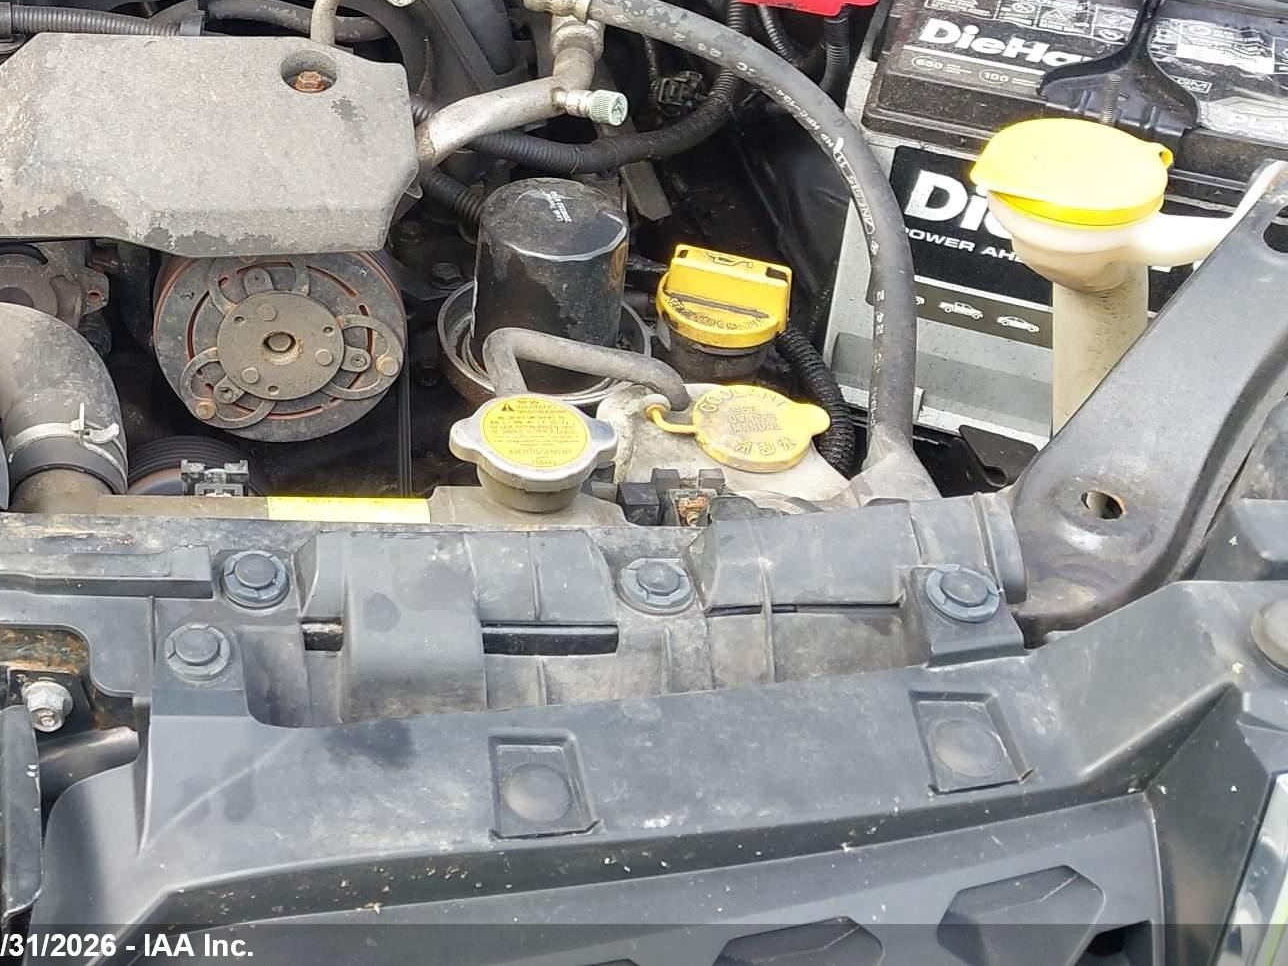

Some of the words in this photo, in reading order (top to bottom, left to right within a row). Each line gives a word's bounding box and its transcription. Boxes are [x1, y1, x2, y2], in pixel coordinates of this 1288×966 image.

[918, 18, 1095, 67] DieHa
[915, 56, 943, 70] 650
[984, 72, 1010, 83] 100
[730, 404, 757, 415] SEE
